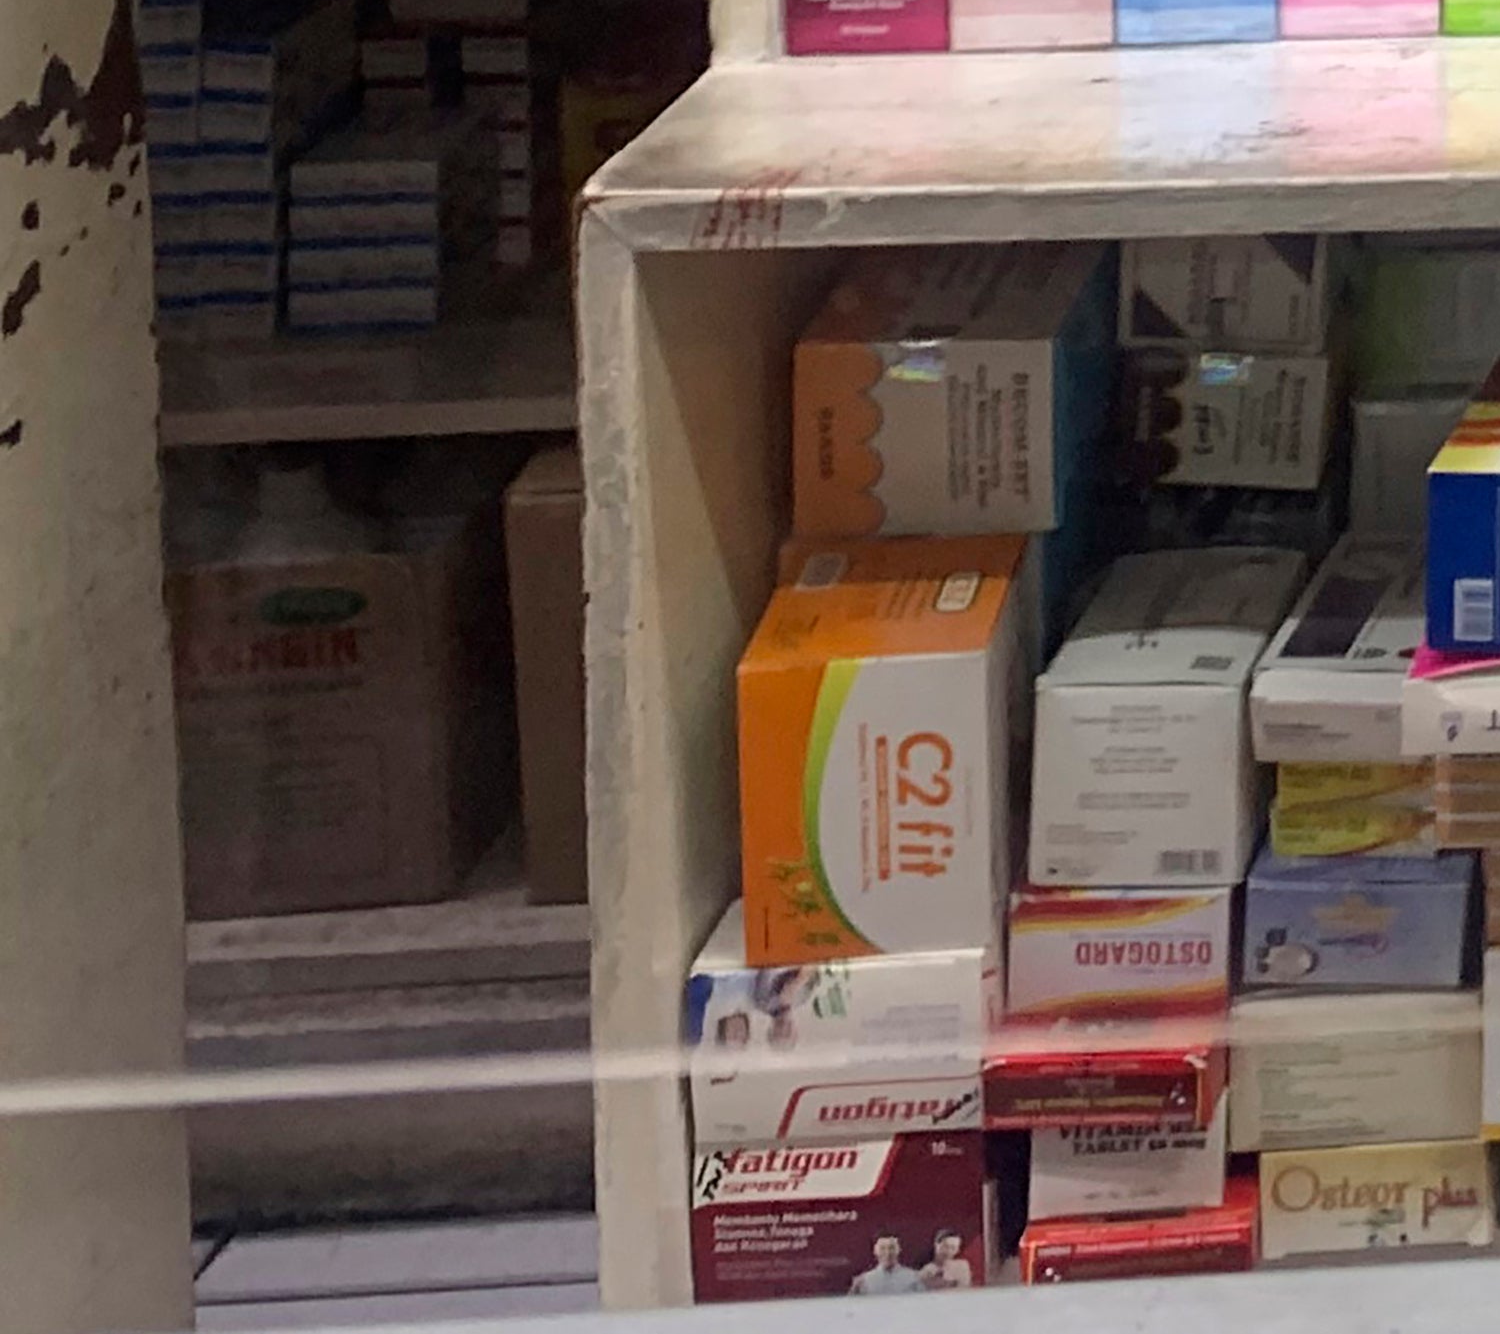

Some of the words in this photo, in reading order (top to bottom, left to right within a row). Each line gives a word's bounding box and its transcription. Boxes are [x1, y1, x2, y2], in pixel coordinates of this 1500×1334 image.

[895, 732, 954, 807] C2
[898, 828, 954, 879] fit
[1076, 941, 1212, 965] OSTOGARD
[725, 1147, 858, 1173] fatigon
